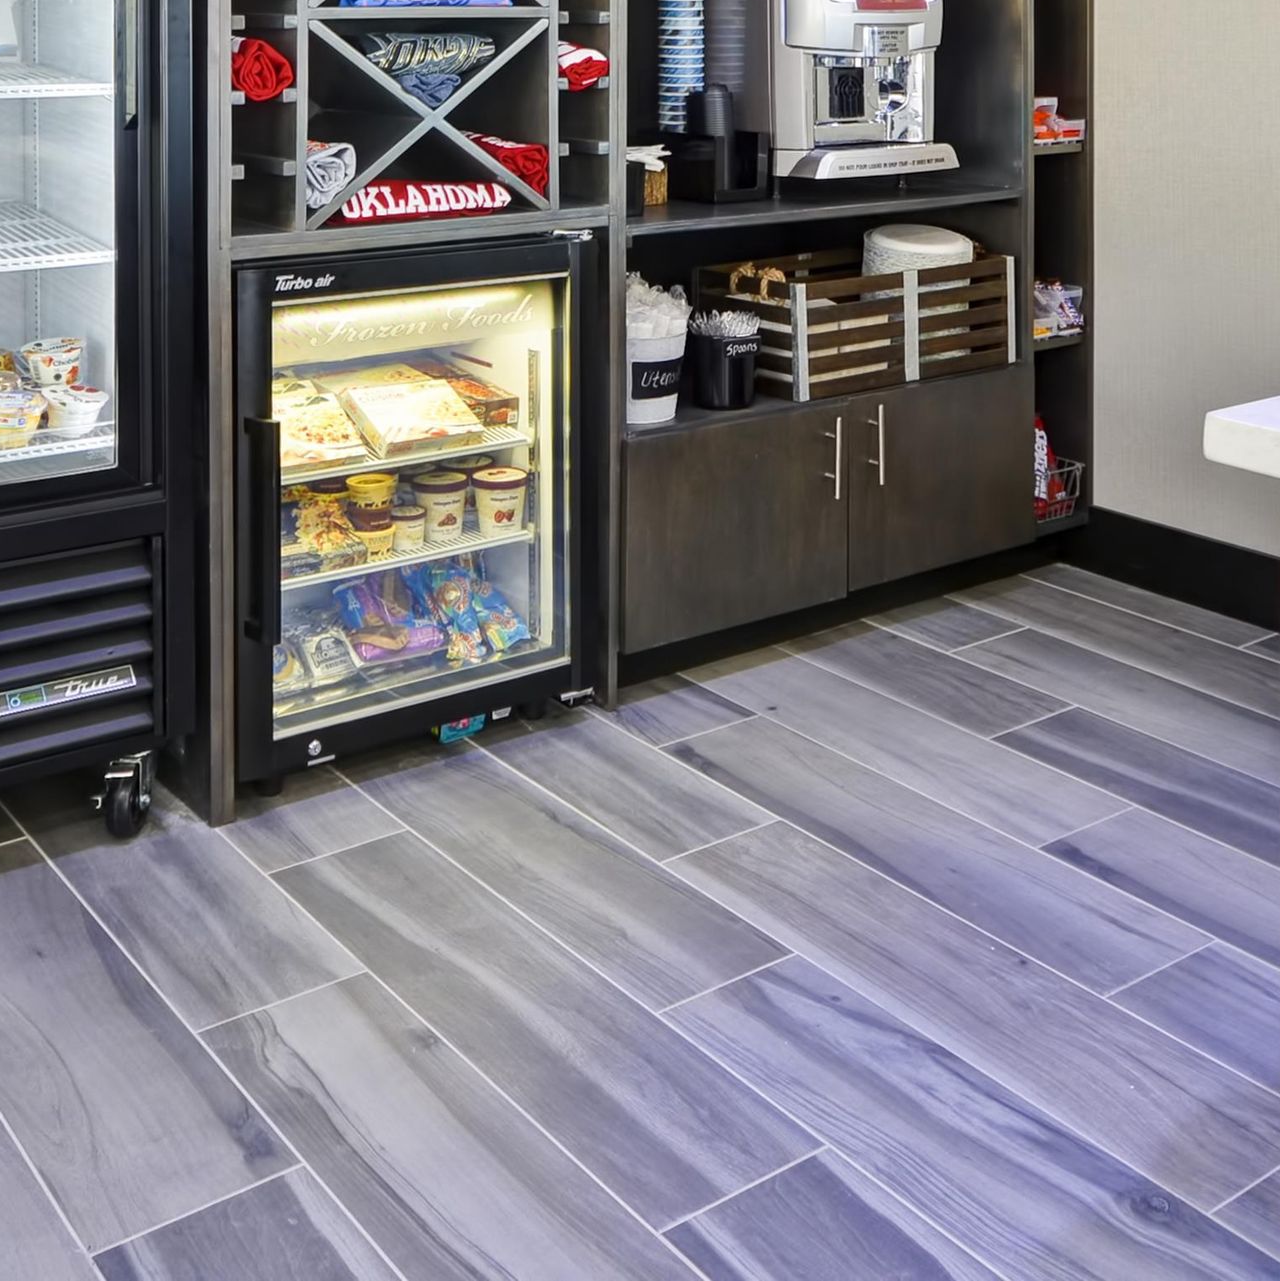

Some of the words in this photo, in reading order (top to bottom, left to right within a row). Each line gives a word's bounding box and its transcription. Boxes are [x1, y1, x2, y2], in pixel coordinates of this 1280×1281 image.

[342, 182, 512, 219] OKLAHOMA
[274, 275, 313, 293] Turbo
[314, 273, 335, 288] air
[310, 320, 428, 347] Frozen
[442, 294, 534, 331] Foods
